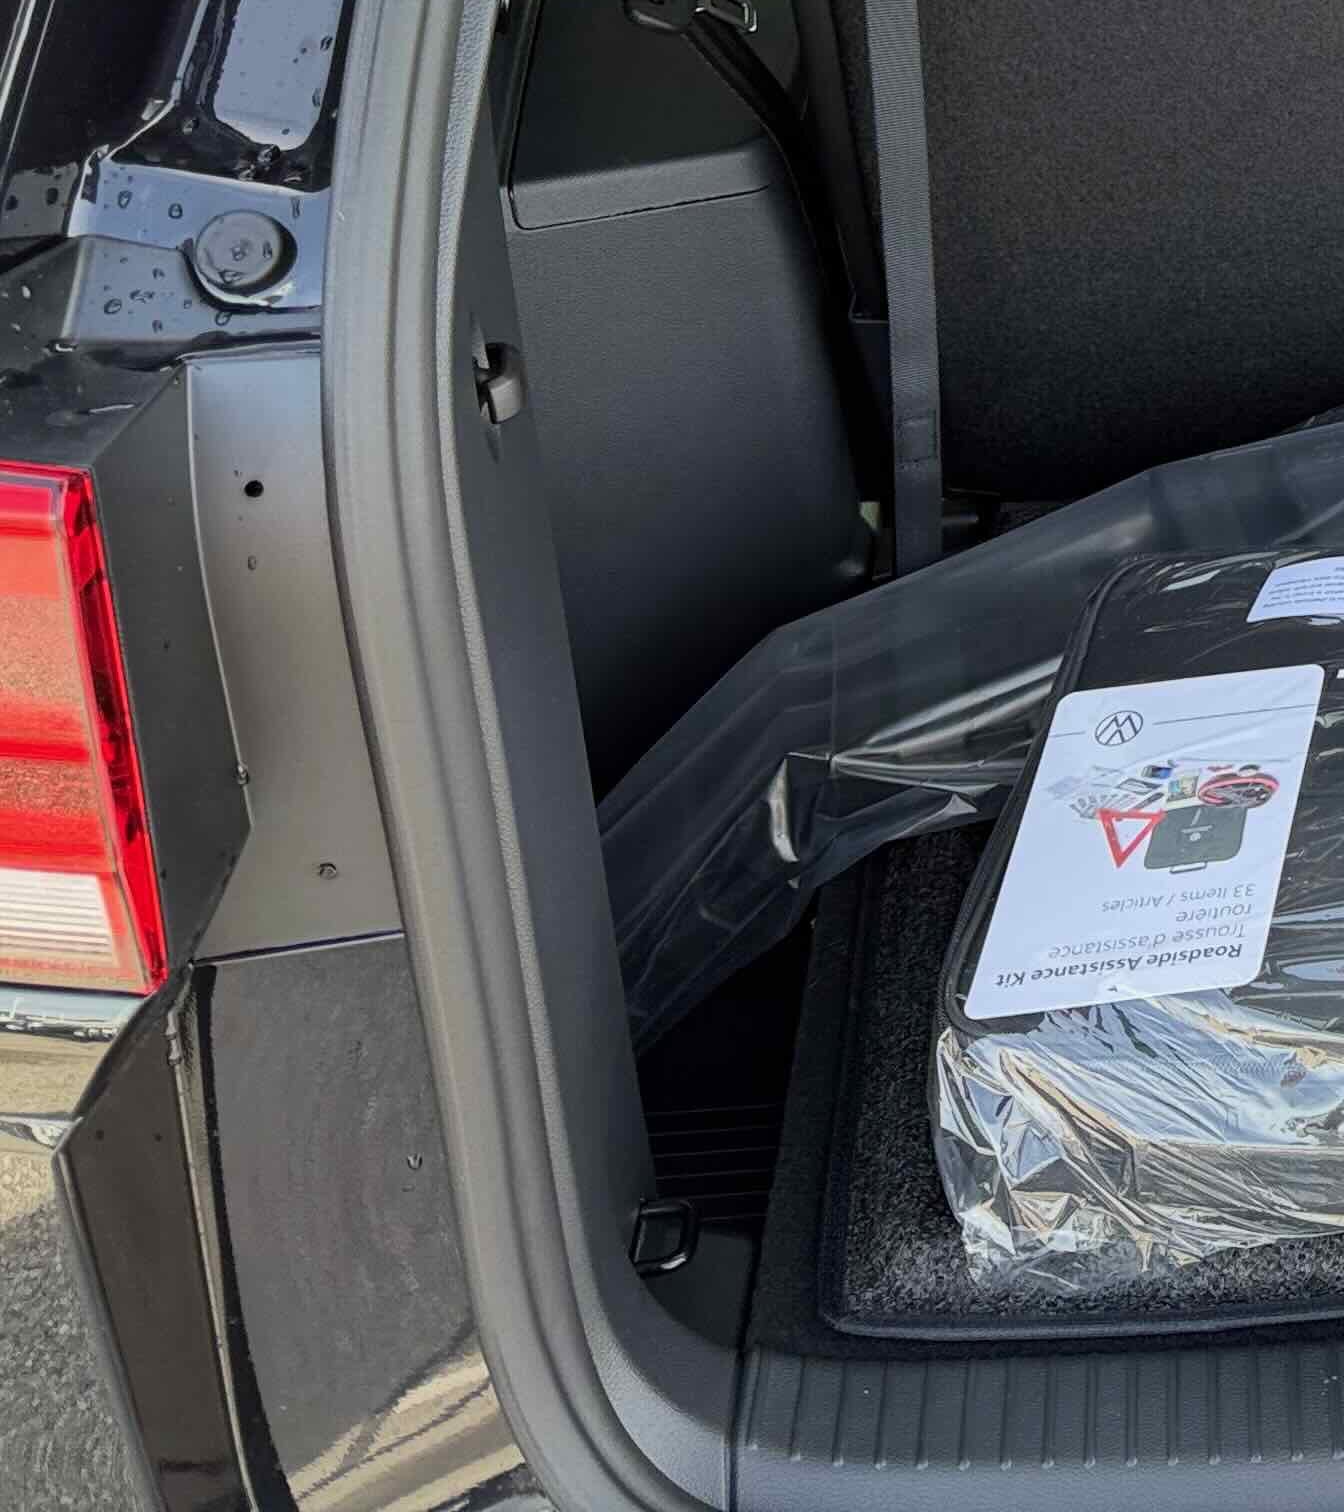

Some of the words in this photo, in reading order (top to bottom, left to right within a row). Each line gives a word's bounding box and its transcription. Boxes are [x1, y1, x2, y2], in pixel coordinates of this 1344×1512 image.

[1181, 886, 1229, 902] Items
[1233, 882, 1256, 897] 33
[1102, 894, 1165, 913] Articles
[1172, 922, 1247, 943] Trousse
[1048, 930, 1167, 958] d'assistance
[1146, 943, 1243, 966] Roadside
[1031, 954, 1146, 981] Assistance
[995, 970, 1025, 987] Kit
